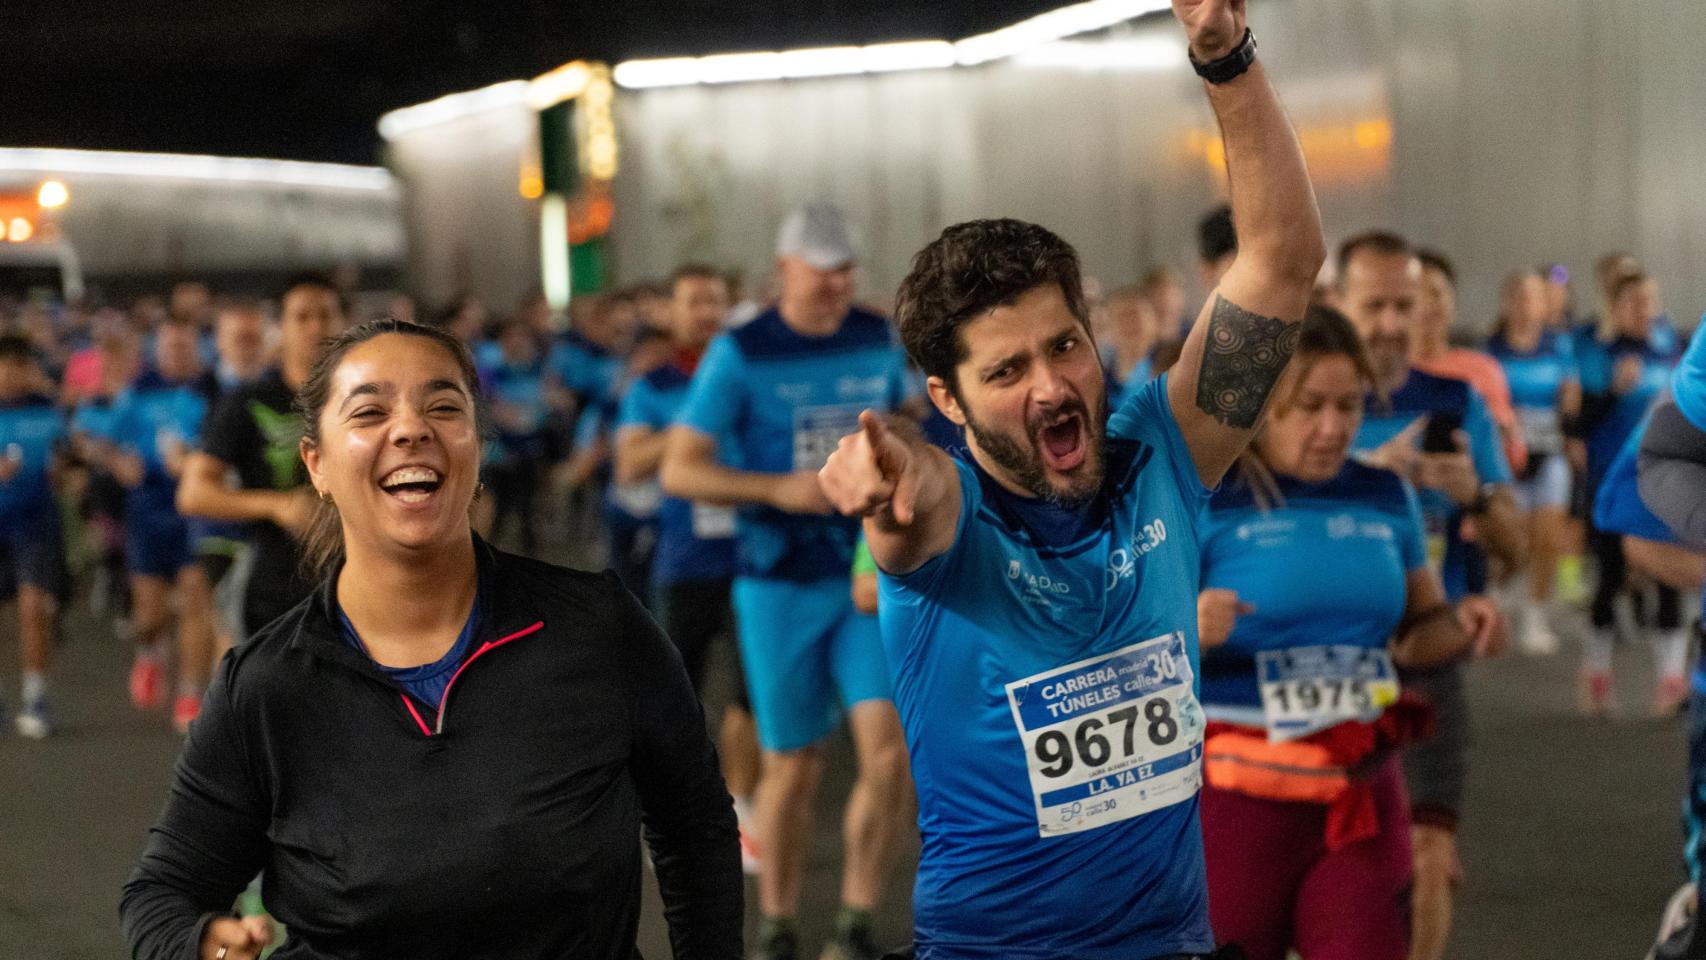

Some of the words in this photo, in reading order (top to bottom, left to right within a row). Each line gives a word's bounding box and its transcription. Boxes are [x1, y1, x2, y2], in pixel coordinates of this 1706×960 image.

[1143, 518, 1166, 547] 30
[1041, 667, 1118, 700] CARRERA
[1118, 658, 1148, 676] madrid
[1147, 649, 1177, 684] 30
[1046, 684, 1121, 718] TÚNELES
[1124, 674, 1153, 692] calle
[1034, 697, 1178, 779] 9678
[1115, 770, 1137, 787] YA
[1060, 801, 1082, 822] 50
[1103, 797, 1117, 812] 30
